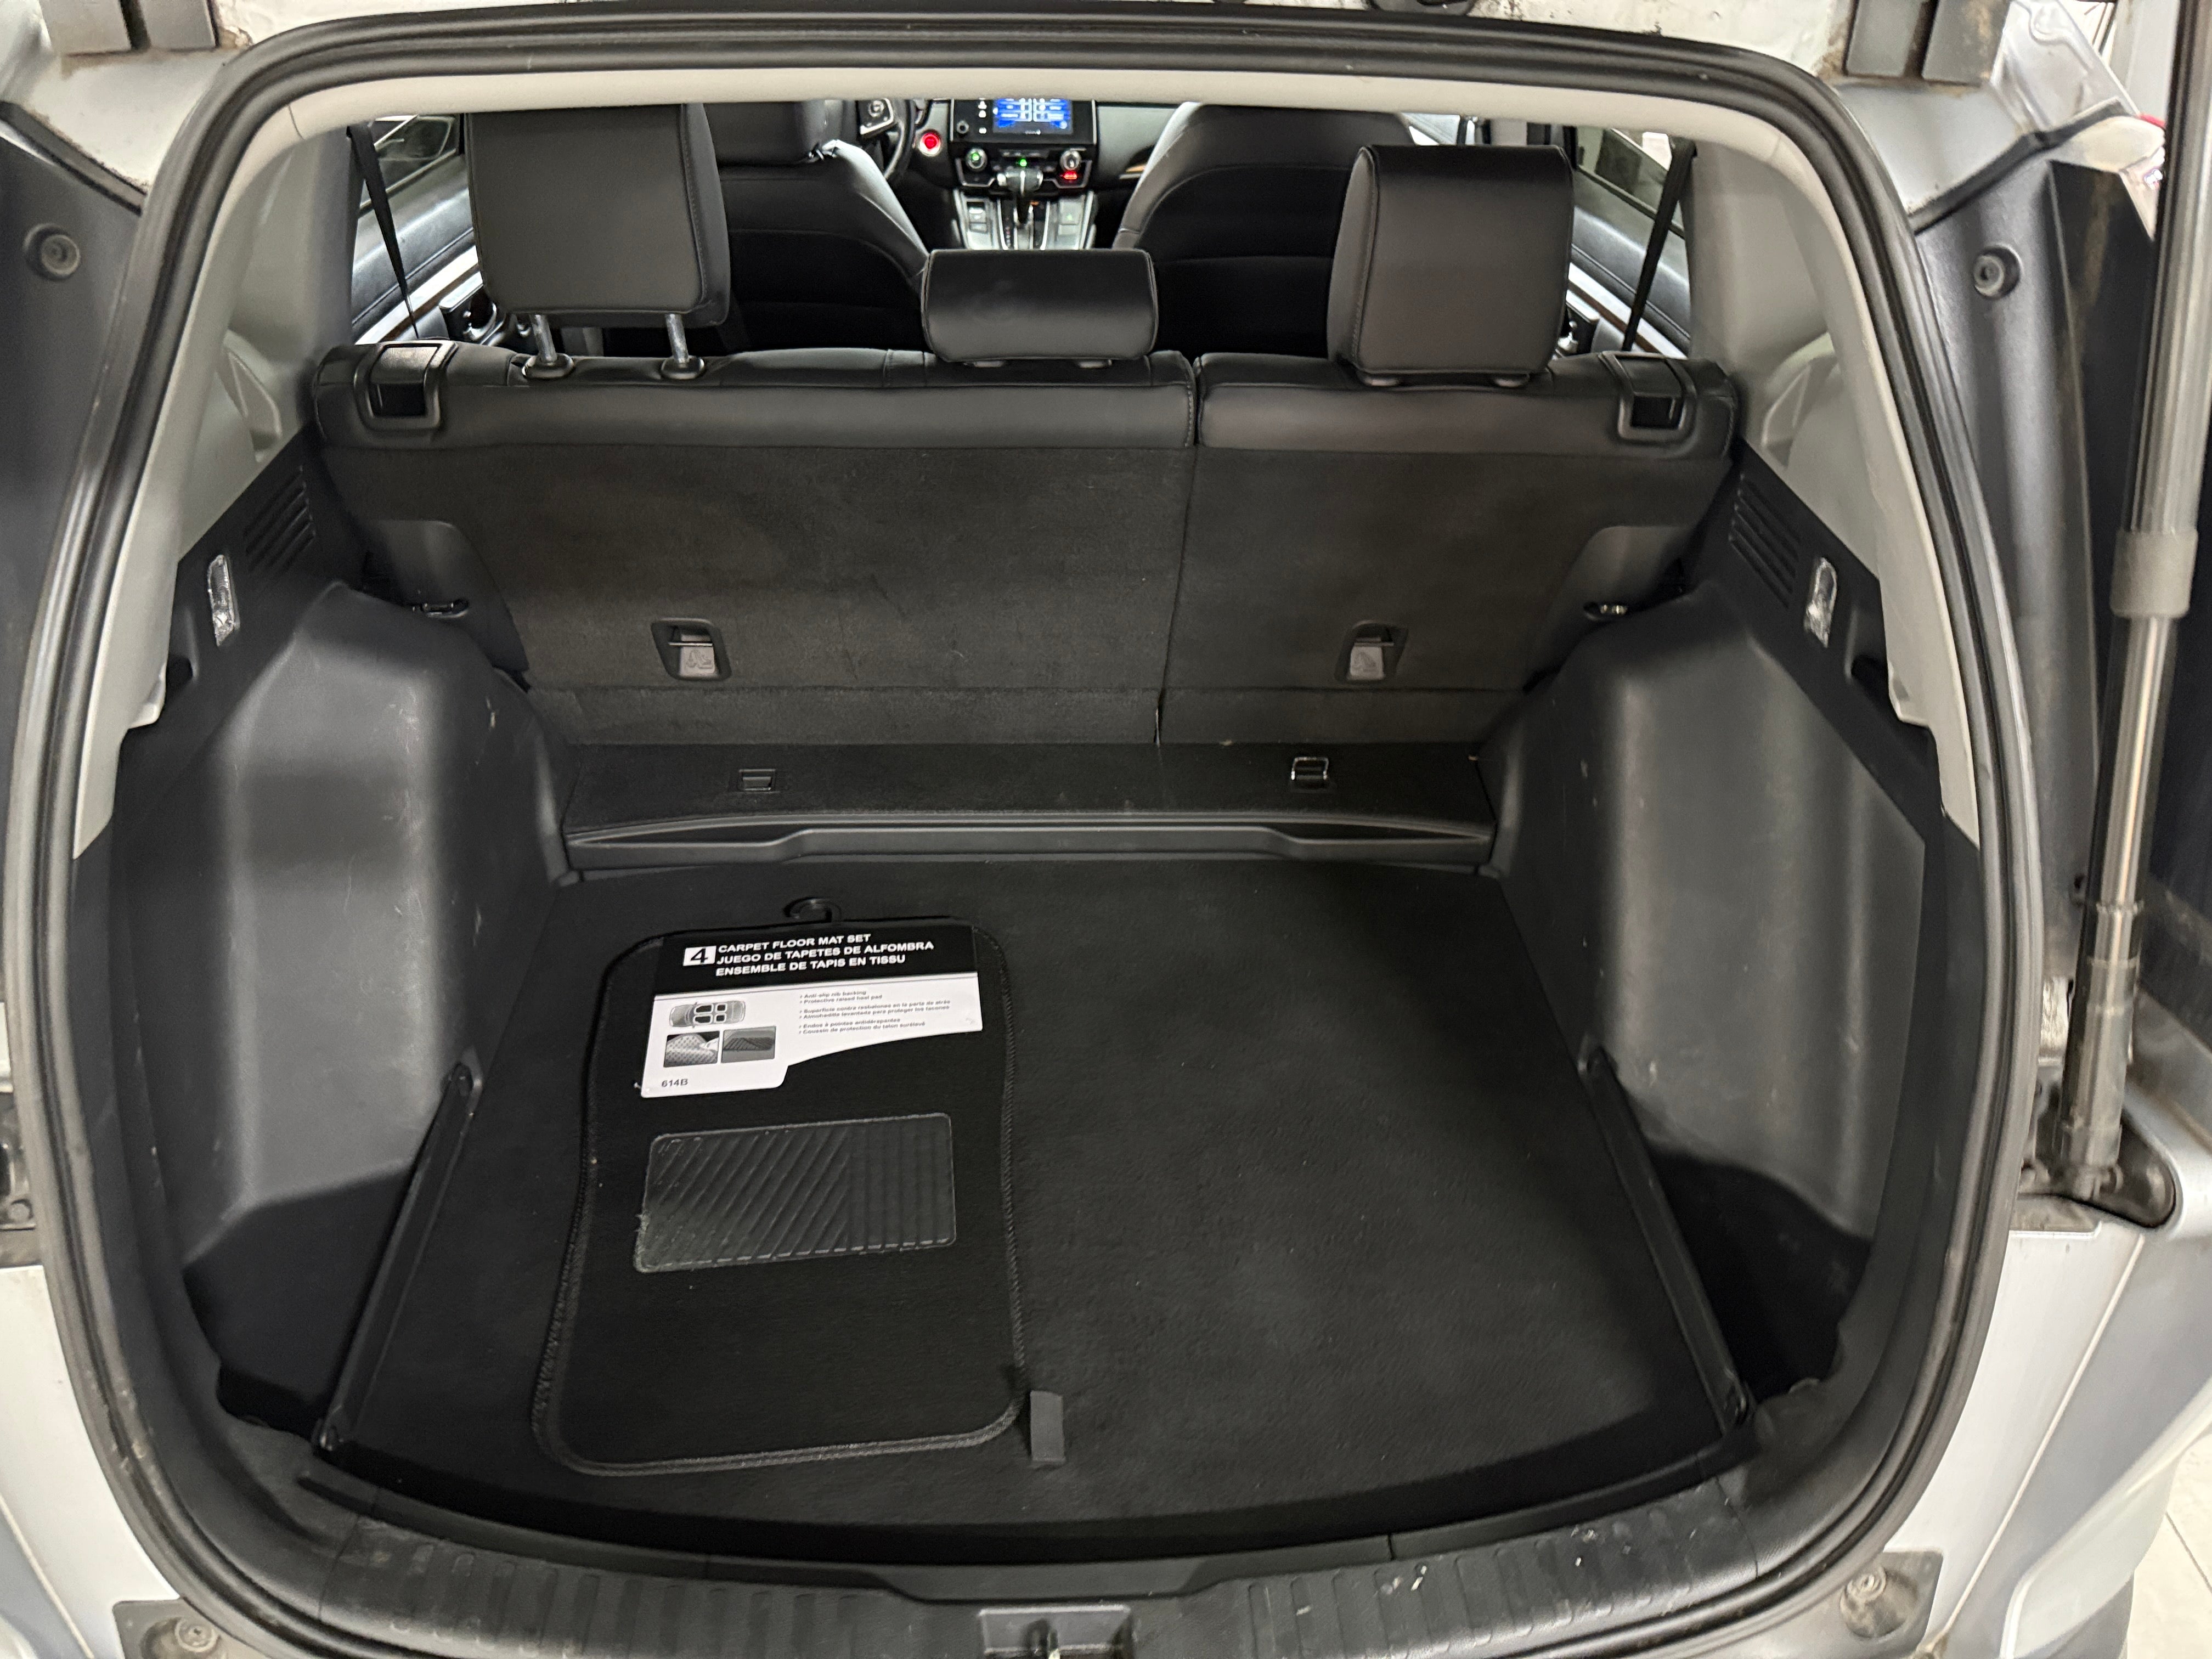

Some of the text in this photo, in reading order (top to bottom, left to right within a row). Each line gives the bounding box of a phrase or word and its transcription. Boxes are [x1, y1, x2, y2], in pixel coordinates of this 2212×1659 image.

[716, 941, 934, 964] JUEGO DE TAPETES DE ALFOMBRA
[718, 934, 871, 953] CARPET FLOOR MAT SET
[691, 948, 708, 964] 4
[716, 955, 906, 977] ENSEMBLE DE TAPIS EN TISSU
[662, 1079, 689, 1087] 614B
